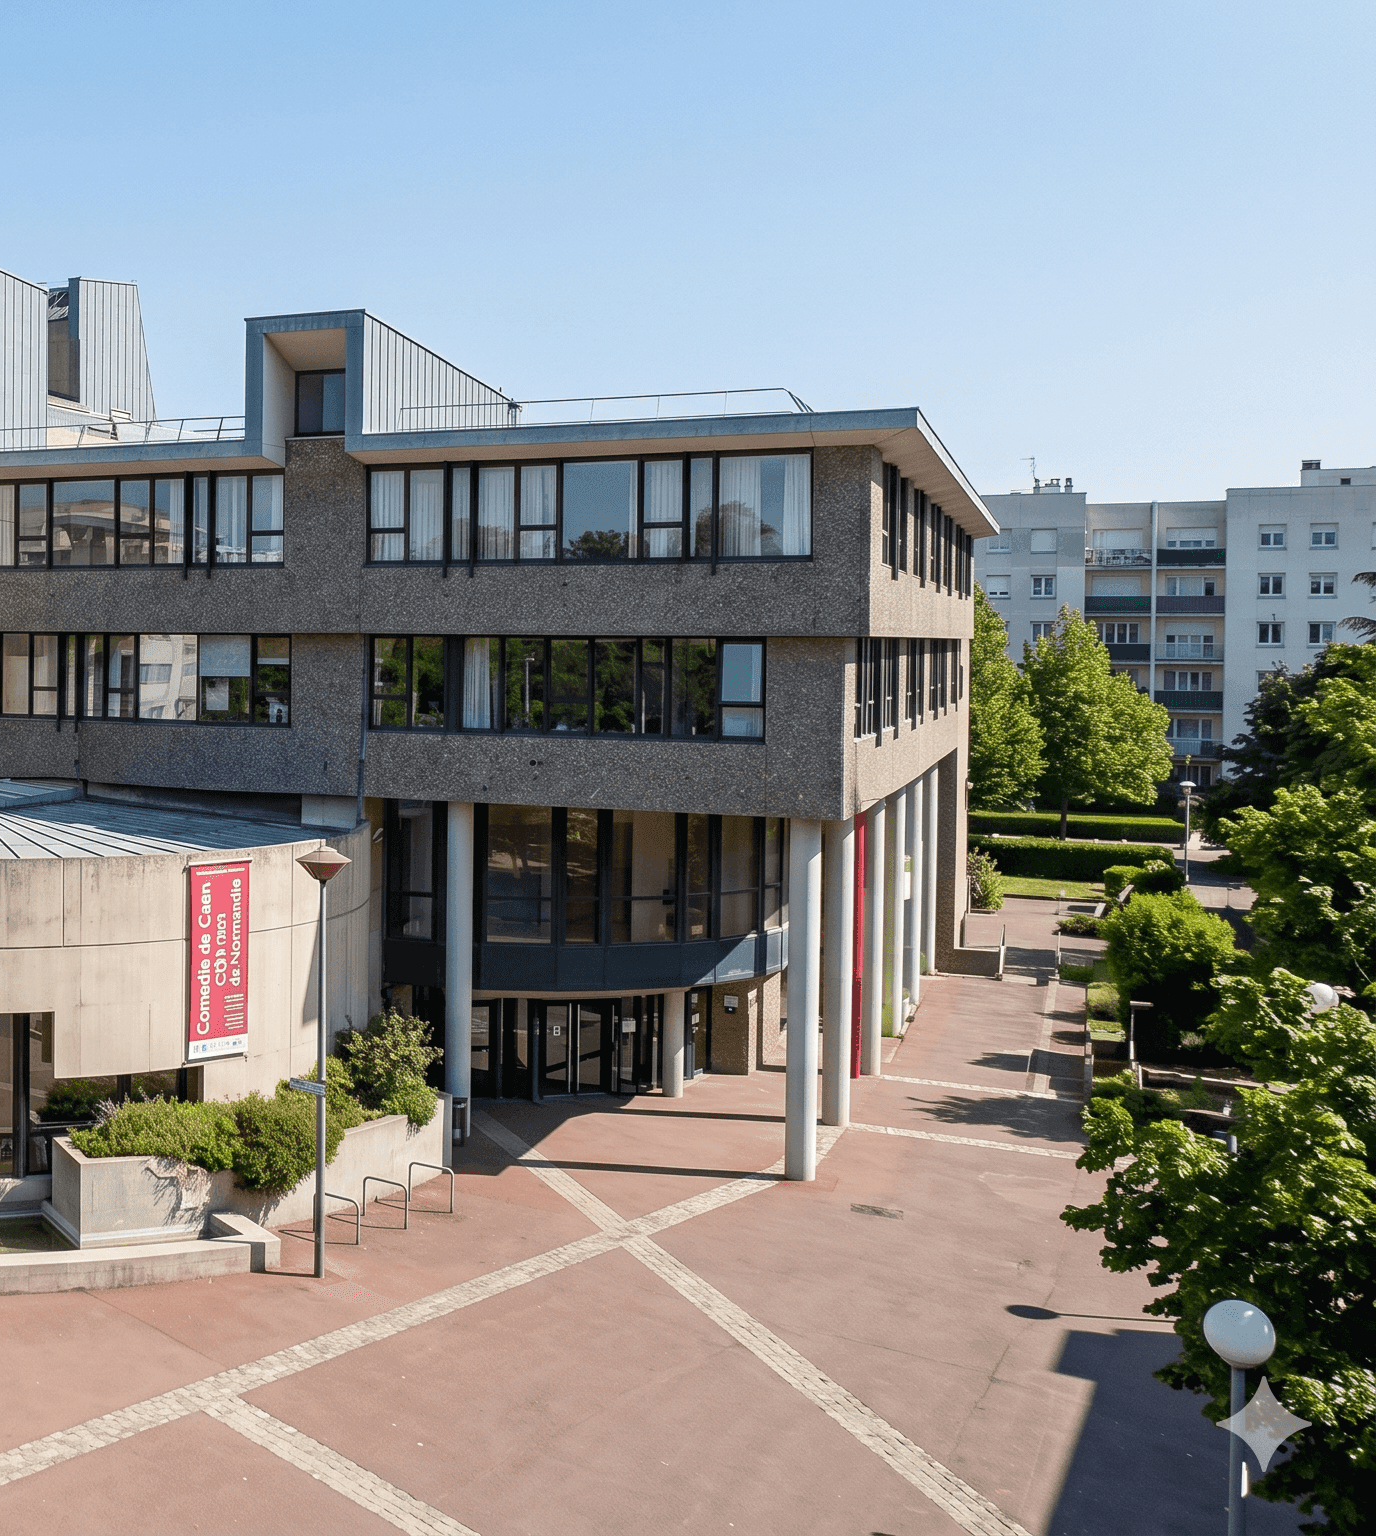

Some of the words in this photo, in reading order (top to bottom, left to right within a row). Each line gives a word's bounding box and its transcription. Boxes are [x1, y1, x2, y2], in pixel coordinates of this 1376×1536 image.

[197, 881, 212, 929] Caen
[229, 878, 242, 965] Normandie
[198, 933, 211, 955] de
